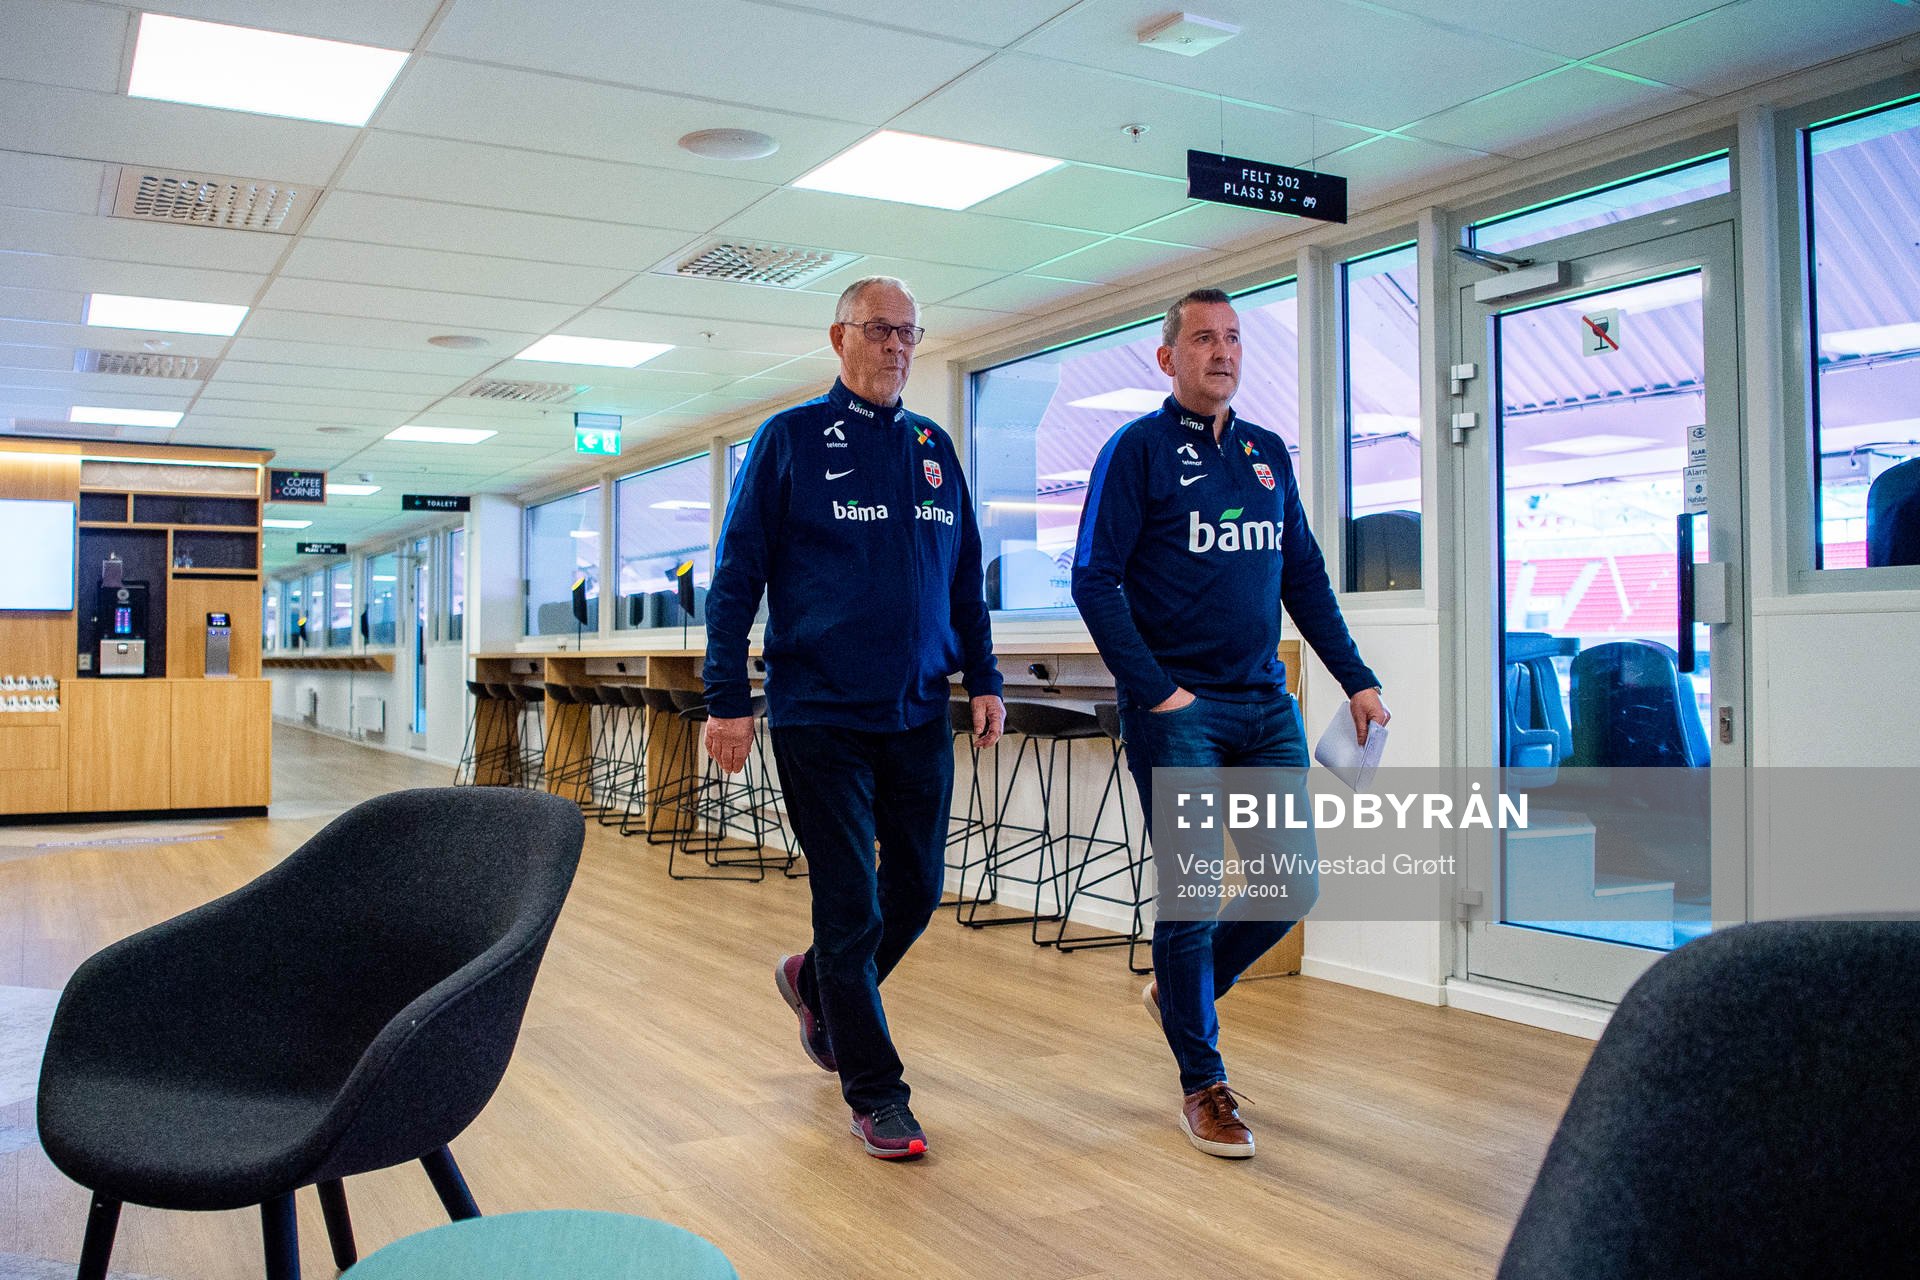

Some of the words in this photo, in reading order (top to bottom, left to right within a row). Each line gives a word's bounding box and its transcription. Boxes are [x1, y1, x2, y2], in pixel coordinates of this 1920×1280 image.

[1242, 168, 1271, 184] FELT
[1277, 176, 1300, 190] 302
[1224, 182, 1264, 200] PLASS
[1270, 190, 1284, 203] 39
[1691, 448, 1706, 456] ALAR
[286, 477, 321, 488] COFFEE
[282, 486, 321, 497] CORNER
[427, 500, 458, 508] TOALETT
[832, 500, 889, 522] bama
